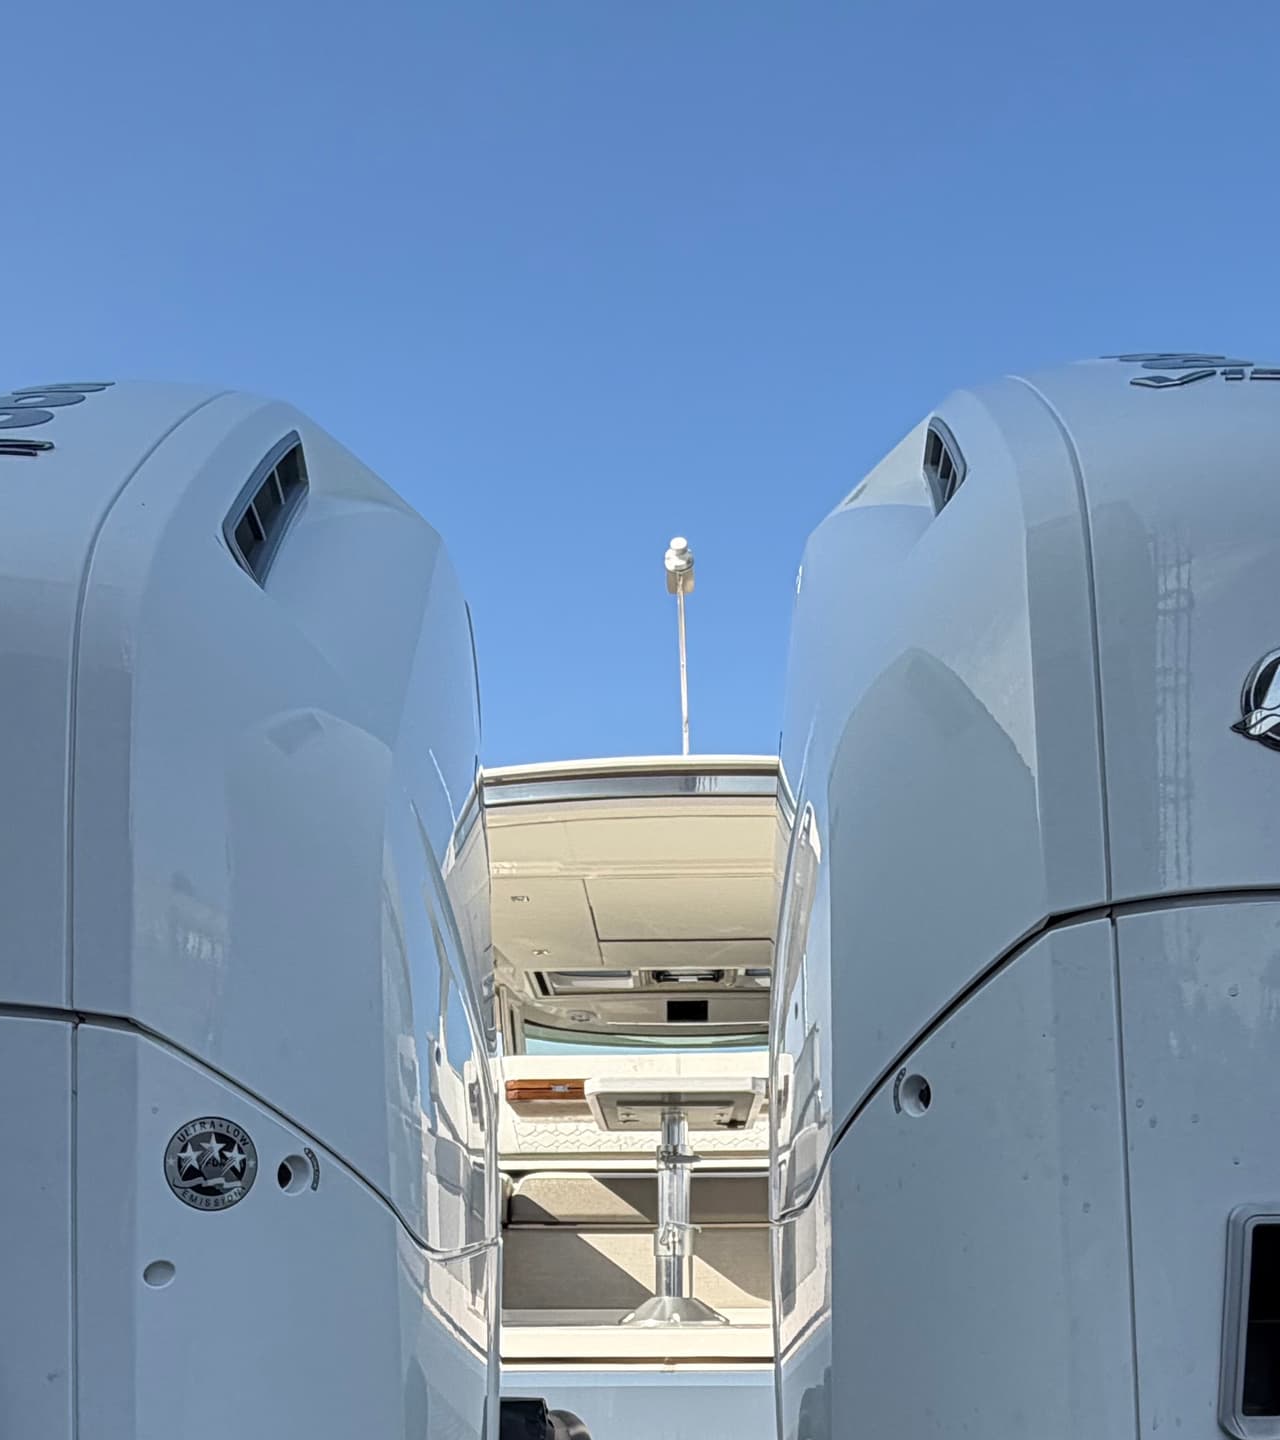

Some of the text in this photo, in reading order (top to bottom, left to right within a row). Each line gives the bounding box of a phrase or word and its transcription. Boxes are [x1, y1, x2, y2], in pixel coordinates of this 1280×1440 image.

[177, 1120, 250, 1147] ULTRA LOW
[181, 1189, 246, 1208] EMISSION
